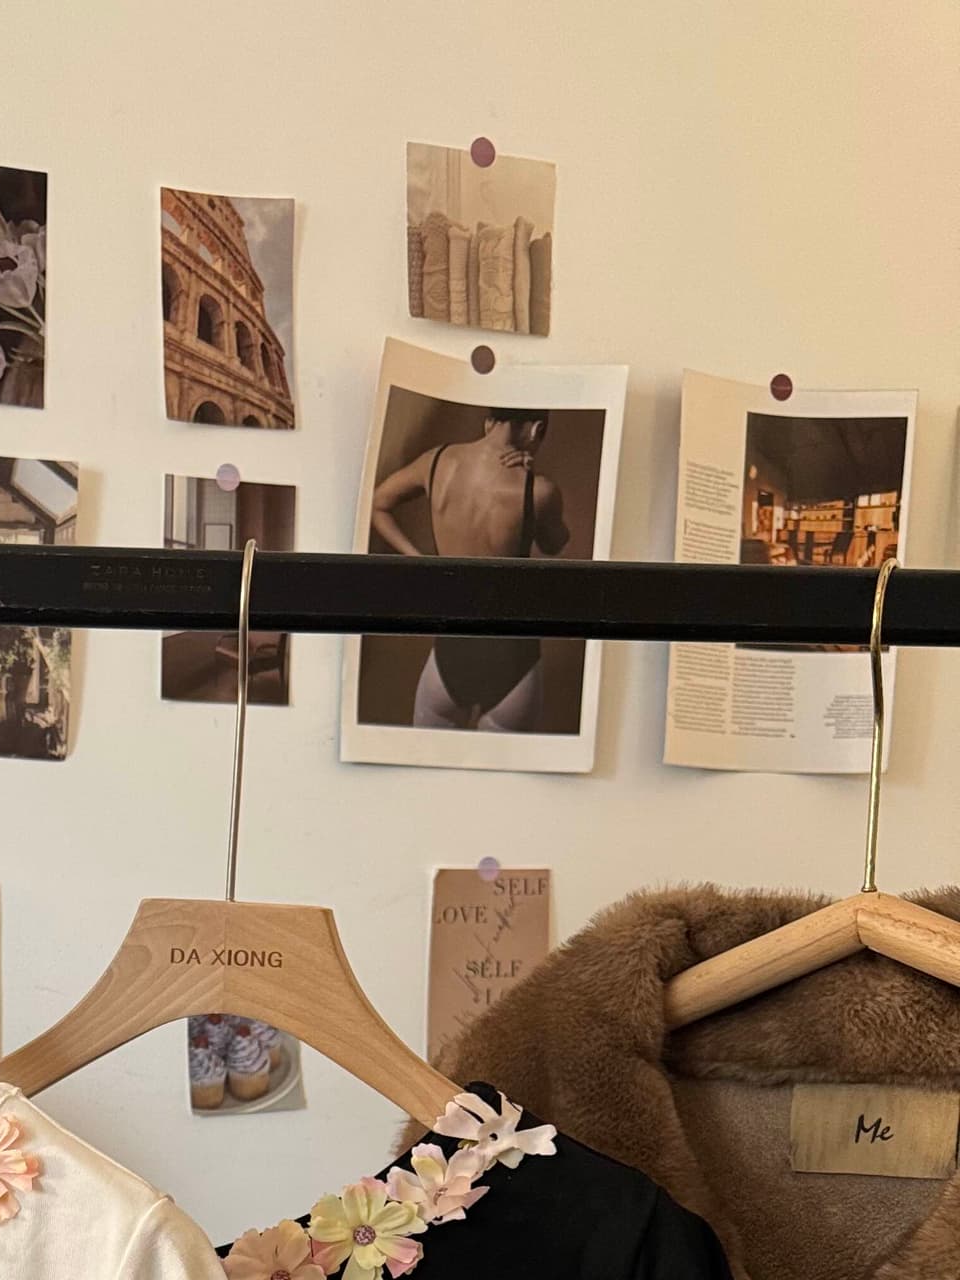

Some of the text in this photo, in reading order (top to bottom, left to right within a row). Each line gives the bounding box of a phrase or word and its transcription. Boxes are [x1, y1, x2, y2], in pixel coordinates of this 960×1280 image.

[493, 878, 549, 896] SELF
[170, 947, 283, 969] DA XIONG
[465, 959, 522, 978] SELF
[854, 1113, 894, 1144] Me
